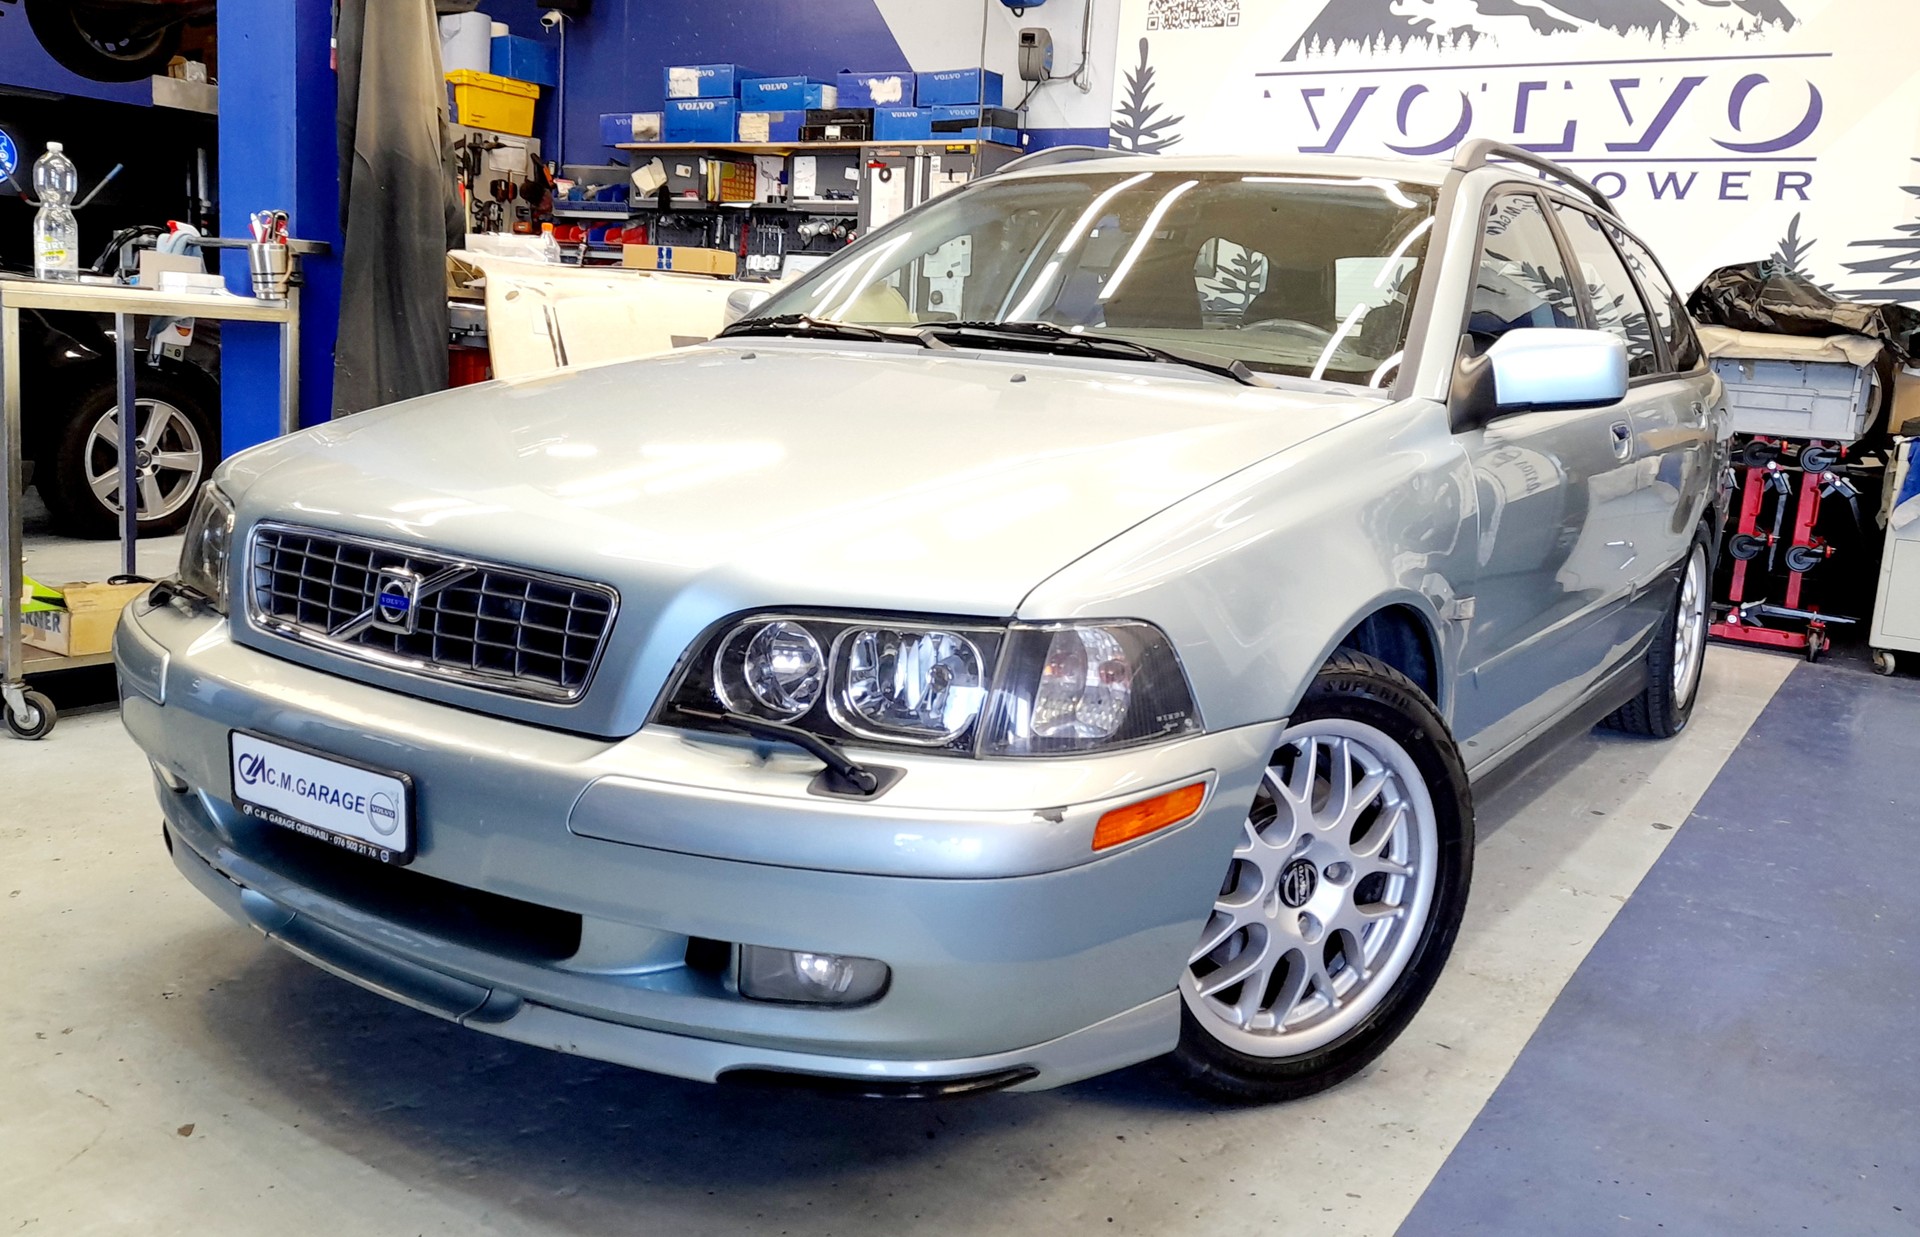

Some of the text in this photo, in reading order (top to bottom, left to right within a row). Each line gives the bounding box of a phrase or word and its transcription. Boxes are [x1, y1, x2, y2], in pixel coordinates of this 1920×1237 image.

[934, 73, 961, 81] VOLVO
[759, 82, 789, 91] VOLVO
[676, 101, 715, 111] VOLVO
[1262, 72, 1824, 154] VOLVO
[381, 596, 406, 607] VOLVO
[266, 768, 366, 815] C.M.GARAGE
[371, 805, 395, 818] VOLVO
[269, 814, 296, 831] GARAGE
[296, 822, 329, 841] OBERHASLI
[333, 835, 345, 847] 076
[359, 845, 367, 854] 21
[368, 848, 377, 858] 76
[1298, 865, 1307, 905] VOLVO
